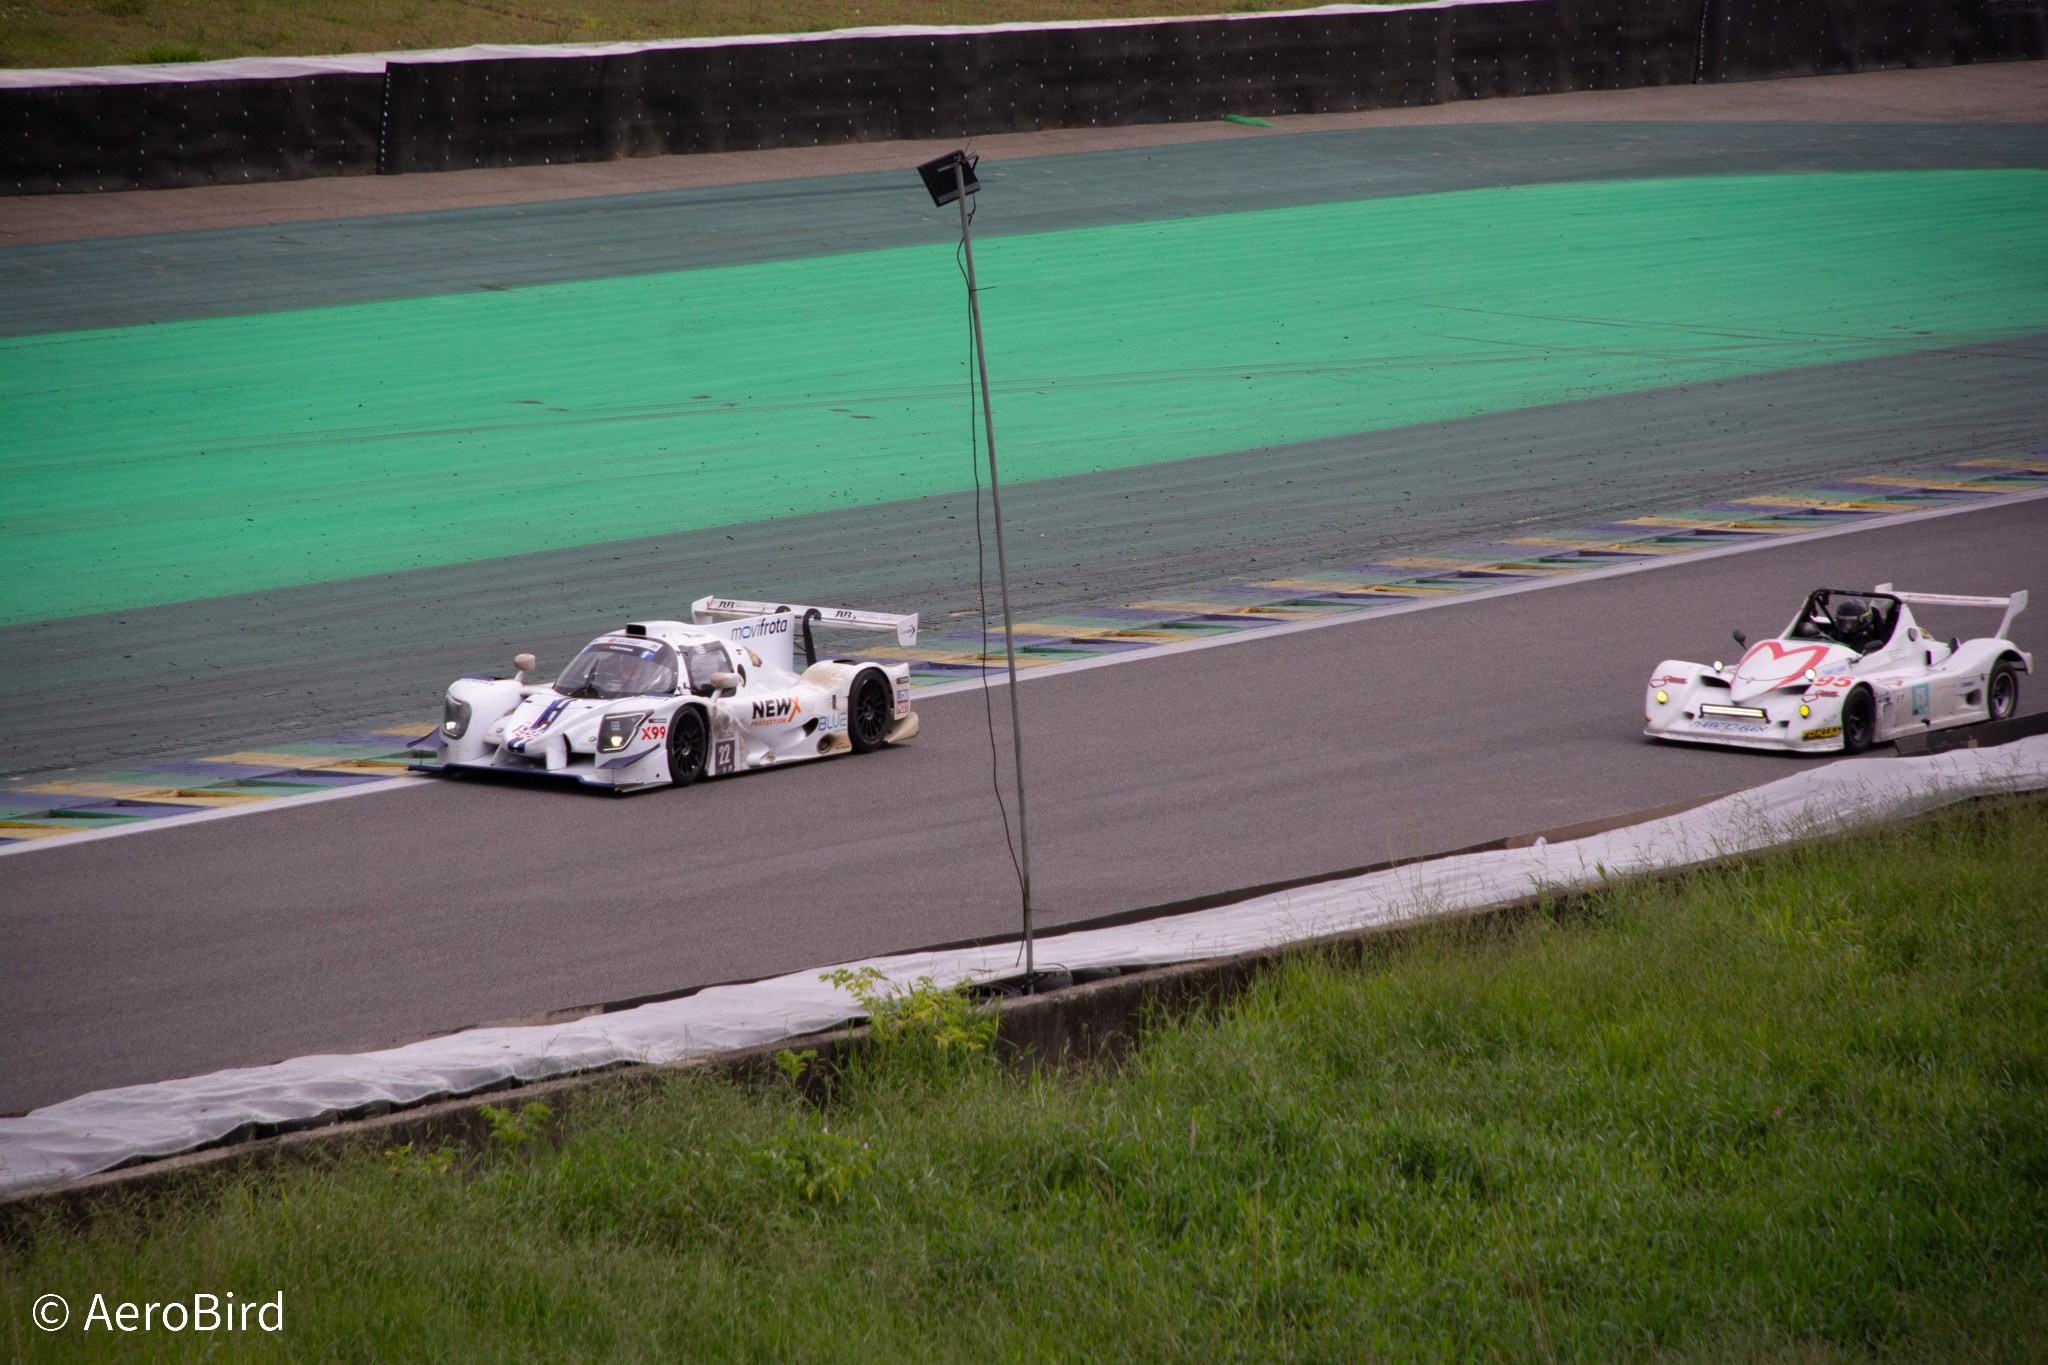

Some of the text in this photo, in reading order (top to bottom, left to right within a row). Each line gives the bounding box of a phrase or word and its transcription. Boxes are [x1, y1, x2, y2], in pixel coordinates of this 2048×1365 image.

[731, 618, 788, 641] movifrota
[1814, 676, 1856, 687] 95
[750, 718, 787, 727] PROTECTION
[818, 712, 847, 731] BLUE
[641, 726, 666, 740] X99
[718, 744, 731, 766] 22
